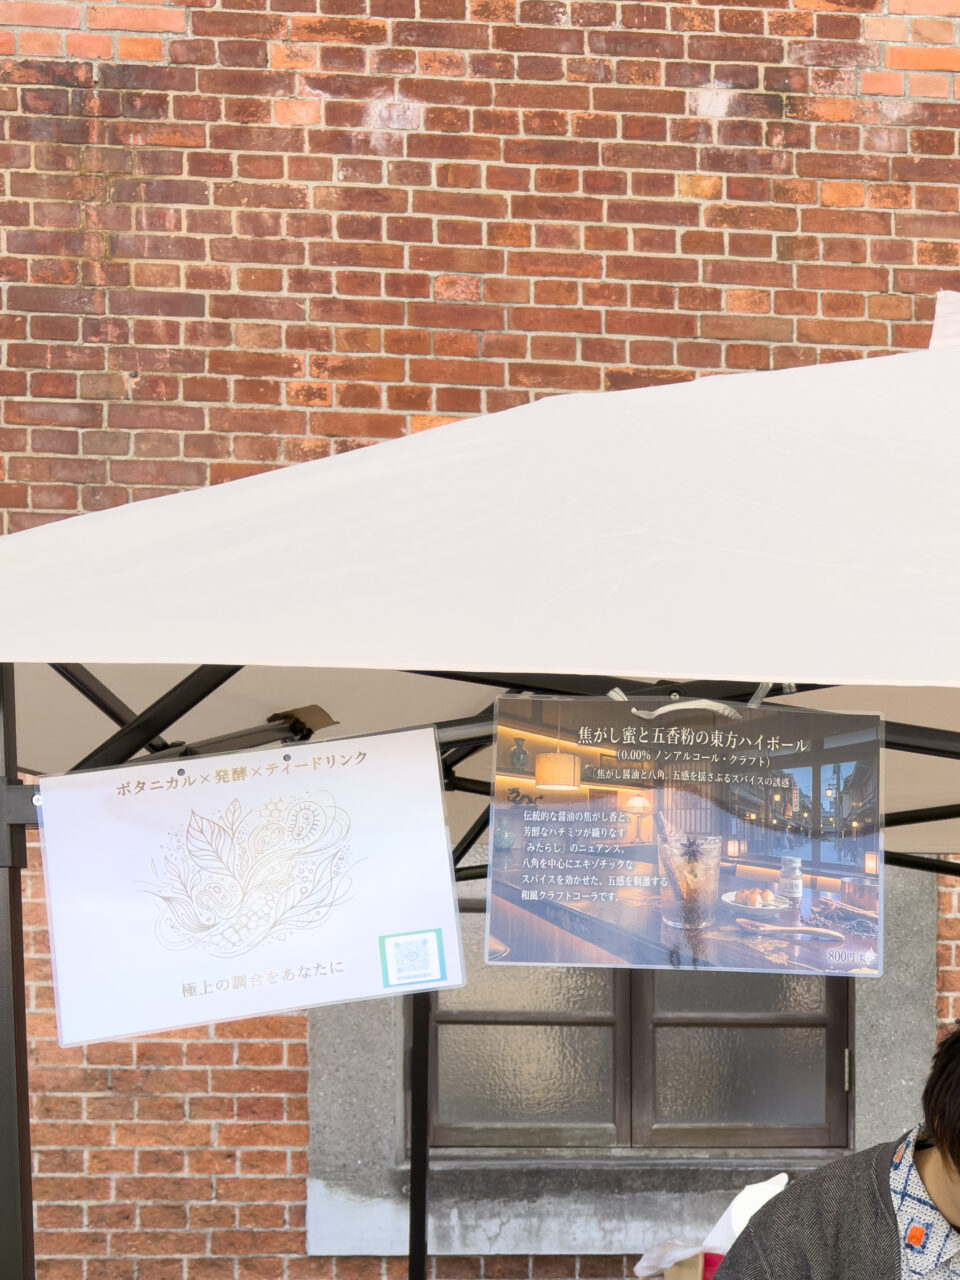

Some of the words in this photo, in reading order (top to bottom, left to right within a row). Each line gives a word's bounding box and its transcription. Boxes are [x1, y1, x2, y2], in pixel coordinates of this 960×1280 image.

[578, 726, 808, 752] 焦がし蜜と五香粉の東方ハイボール
[117, 751, 367, 796] ボタニカル×発酵×ティードリンク
[522, 858, 633, 870] 八角を中心にエキゾチックな
[181, 961, 344, 998] 極上の調合をあなたに
